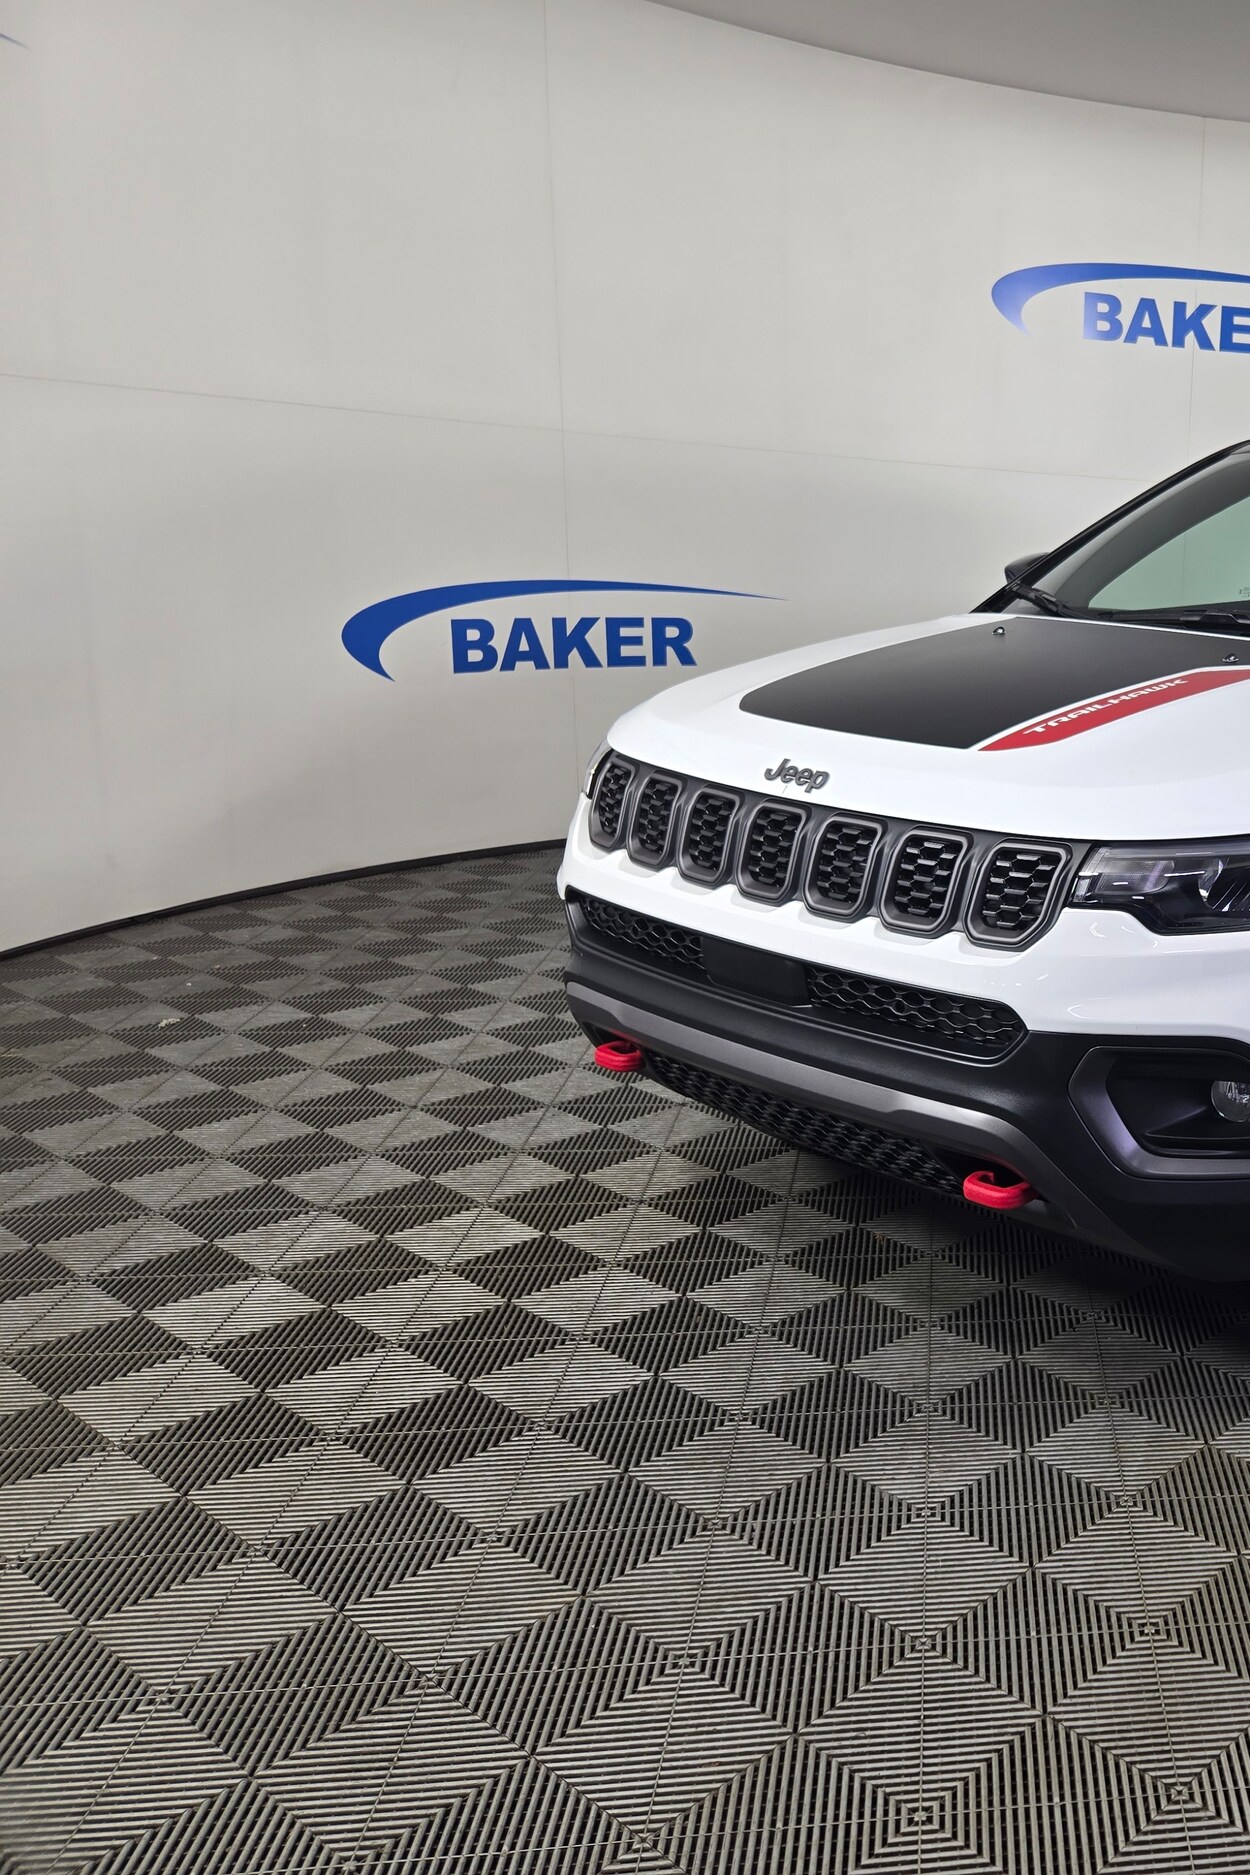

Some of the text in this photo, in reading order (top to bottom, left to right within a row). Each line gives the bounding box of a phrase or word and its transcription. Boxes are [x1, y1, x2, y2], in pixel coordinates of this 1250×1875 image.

[450, 617, 698, 674] BAKER
[1022, 678, 1189, 735] TRAILHAWK
[764, 758, 830, 793] Jeep
